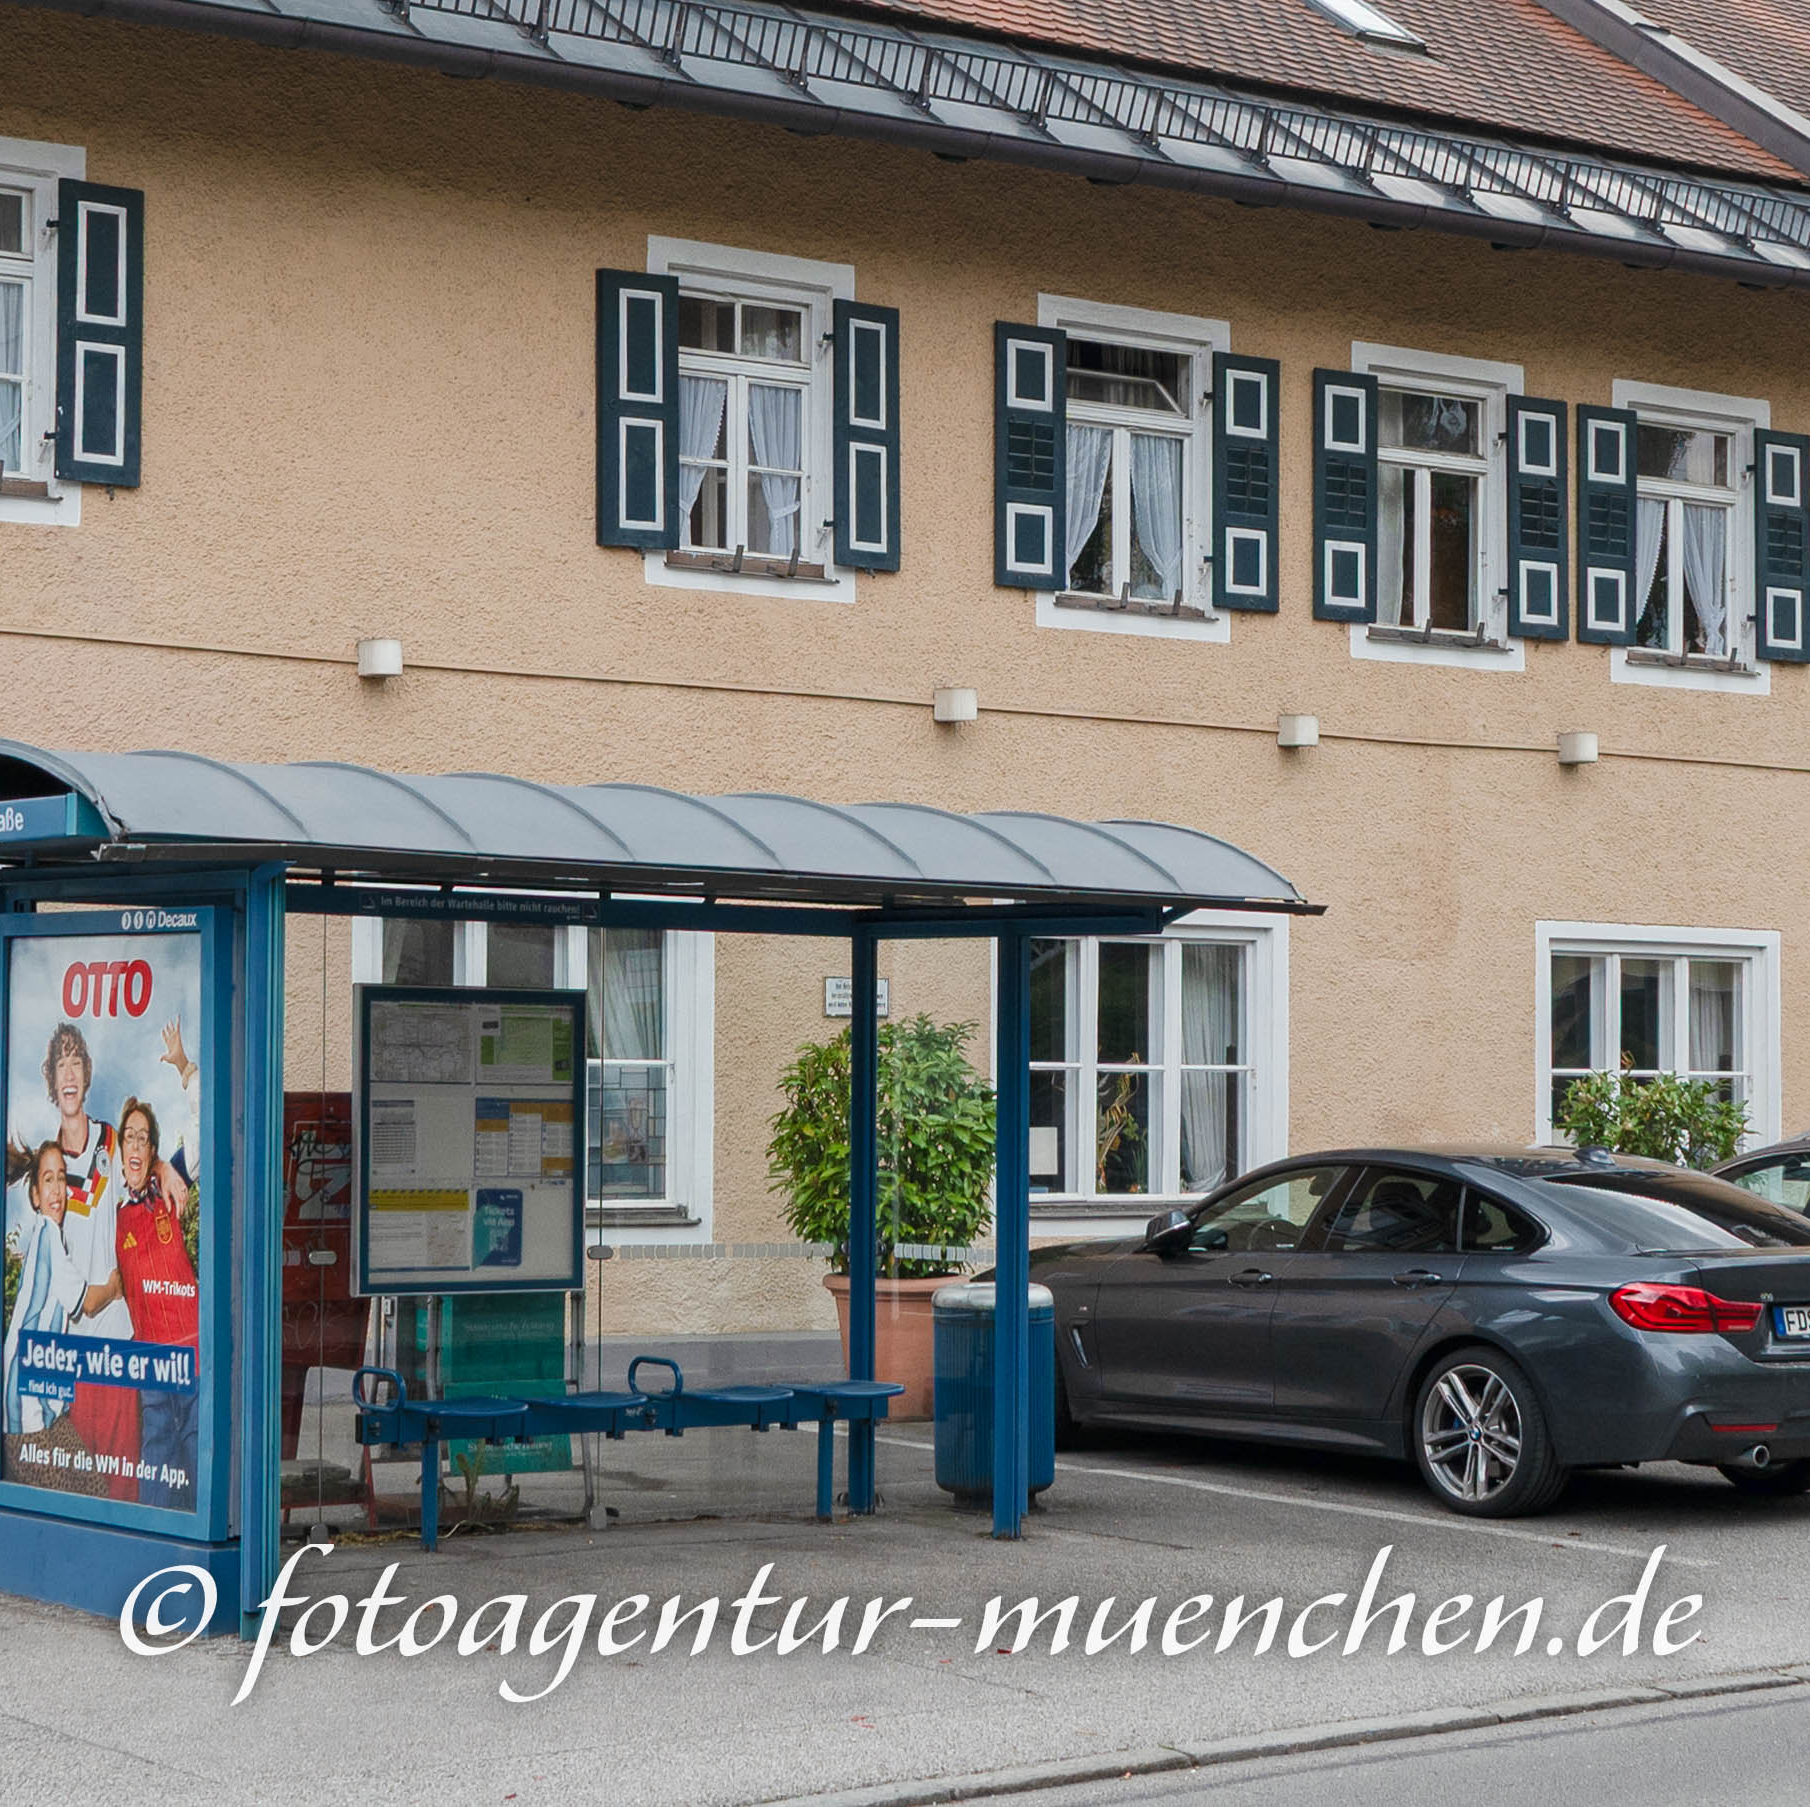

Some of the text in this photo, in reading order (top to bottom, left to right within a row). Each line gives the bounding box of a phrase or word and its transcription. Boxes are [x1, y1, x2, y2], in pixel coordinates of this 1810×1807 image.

[380, 895, 393, 906] Im
[395, 896, 428, 909] Bereich
[430, 897, 445, 908] der
[447, 898, 494, 911] Wartehalle
[497, 901, 517, 911] bitte
[519, 902, 542, 913] nicht
[62, 959, 153, 1018] OTTO
[142, 1279, 196, 1297] WM-Trikots
[22, 1339, 191, 1386] Jeder, wie er will
[29, 1379, 45, 1394] find
[45, 1382, 57, 1396] ich
[58, 1386, 74, 1400] gut.
[19, 1444, 190, 1489] Alles für die WM in der App.
